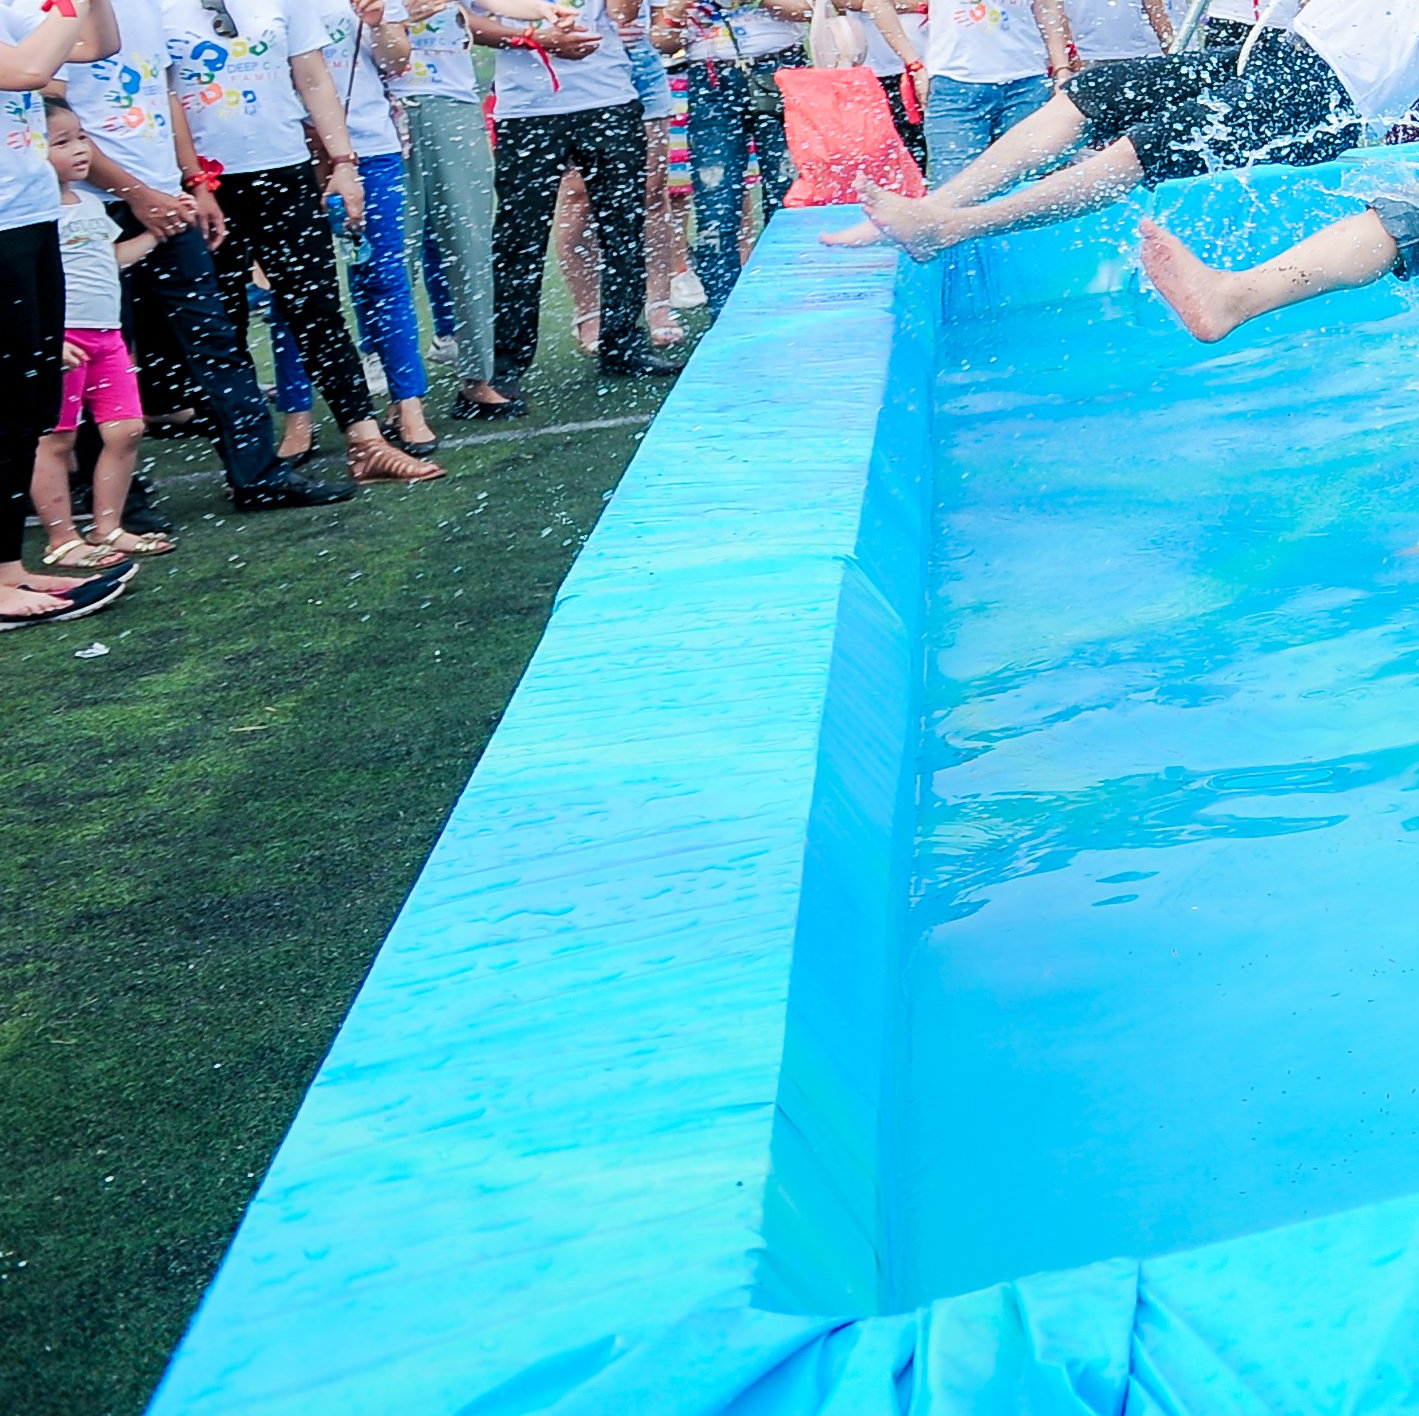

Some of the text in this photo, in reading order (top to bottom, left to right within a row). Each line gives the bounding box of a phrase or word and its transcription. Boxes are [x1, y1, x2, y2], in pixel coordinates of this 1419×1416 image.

[227, 60, 272, 74] DEEP C
[230, 72, 280, 83] FAMIL
